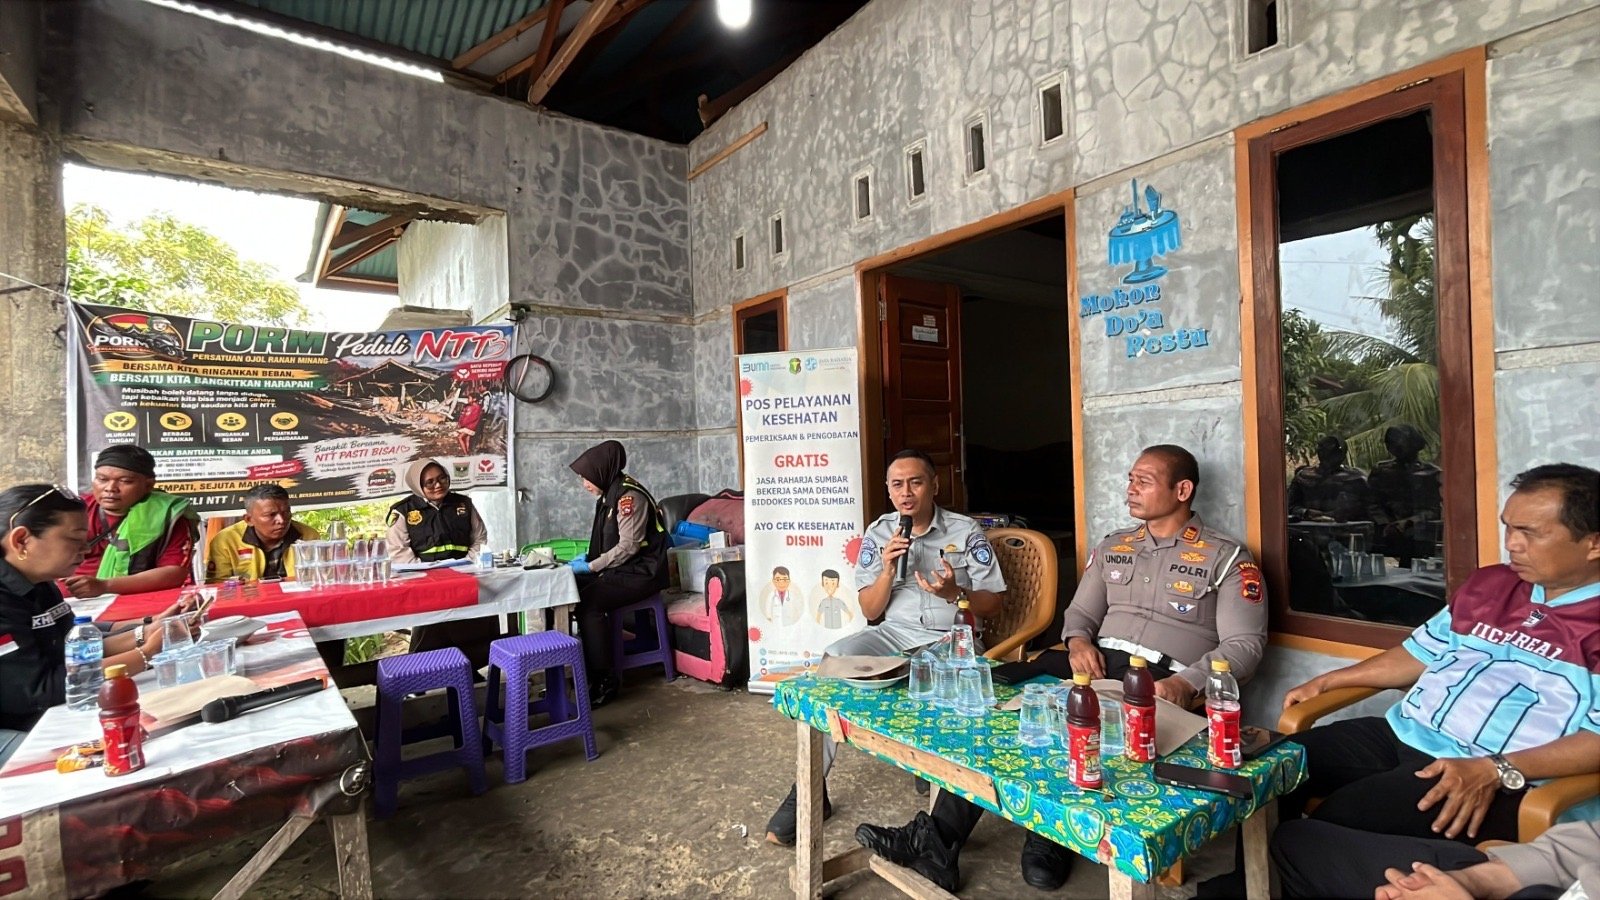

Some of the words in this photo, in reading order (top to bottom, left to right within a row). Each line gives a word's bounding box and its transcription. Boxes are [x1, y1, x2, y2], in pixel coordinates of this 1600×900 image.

[1079, 284, 1161, 318] Mohon
[1105, 309, 1164, 337] Do'a
[95, 335, 149, 348] PORM
[187, 320, 328, 354] PORM
[331, 332, 409, 358] Peduli
[413, 330, 498, 362] NTT
[1126, 328, 1209, 358] Restu
[192, 353, 243, 362] PERSATUAN
[268, 356, 295, 364] RANAH
[123, 362, 173, 370] BERSAMA
[177, 365, 199, 373] KITA
[202, 368, 258, 377] RINGANKAN
[110, 373, 163, 383] BERSATU
[167, 375, 190, 384] KITA
[194, 377, 261, 388] BANGKITKAN
[264, 380, 314, 388] HARAPAN!
[746, 399, 771, 411] POS
[775, 394, 852, 409] PELAYANAN
[762, 411, 838, 426] KESEHATAN
[745, 433, 798, 442] PEMERIKSAAN
[807, 431, 858, 440] PENGOBATAN
[314, 443, 347, 453] Bangkit
[350, 440, 388, 449] Bersama,
[315, 452, 338, 462] NTT
[339, 449, 368, 459] PASTI
[372, 446, 399, 457] BISA!
[775, 454, 829, 468] GRATIS
[200, 482, 235, 490] SEJUTA
[756, 477, 776, 485] JASA
[778, 476, 813, 484] RAHARJA
[815, 475, 848, 483] SUMBAR
[757, 487, 791, 495] BEKERJA
[816, 486, 849, 494] DENGAN
[206, 496, 228, 504] NTT
[752, 498, 793, 506] BIDDOKES
[794, 497, 820, 505] POLDA
[822, 497, 856, 505] SUMBAR
[754, 522, 773, 531] AYO
[776, 522, 795, 530] CEK
[798, 522, 854, 530] KESEHATAN
[786, 535, 824, 546] DISINI
[1105, 554, 1133, 565] UNDRA
[1169, 564, 1208, 579] POLRI
[1402, 649, 1582, 756] 30
